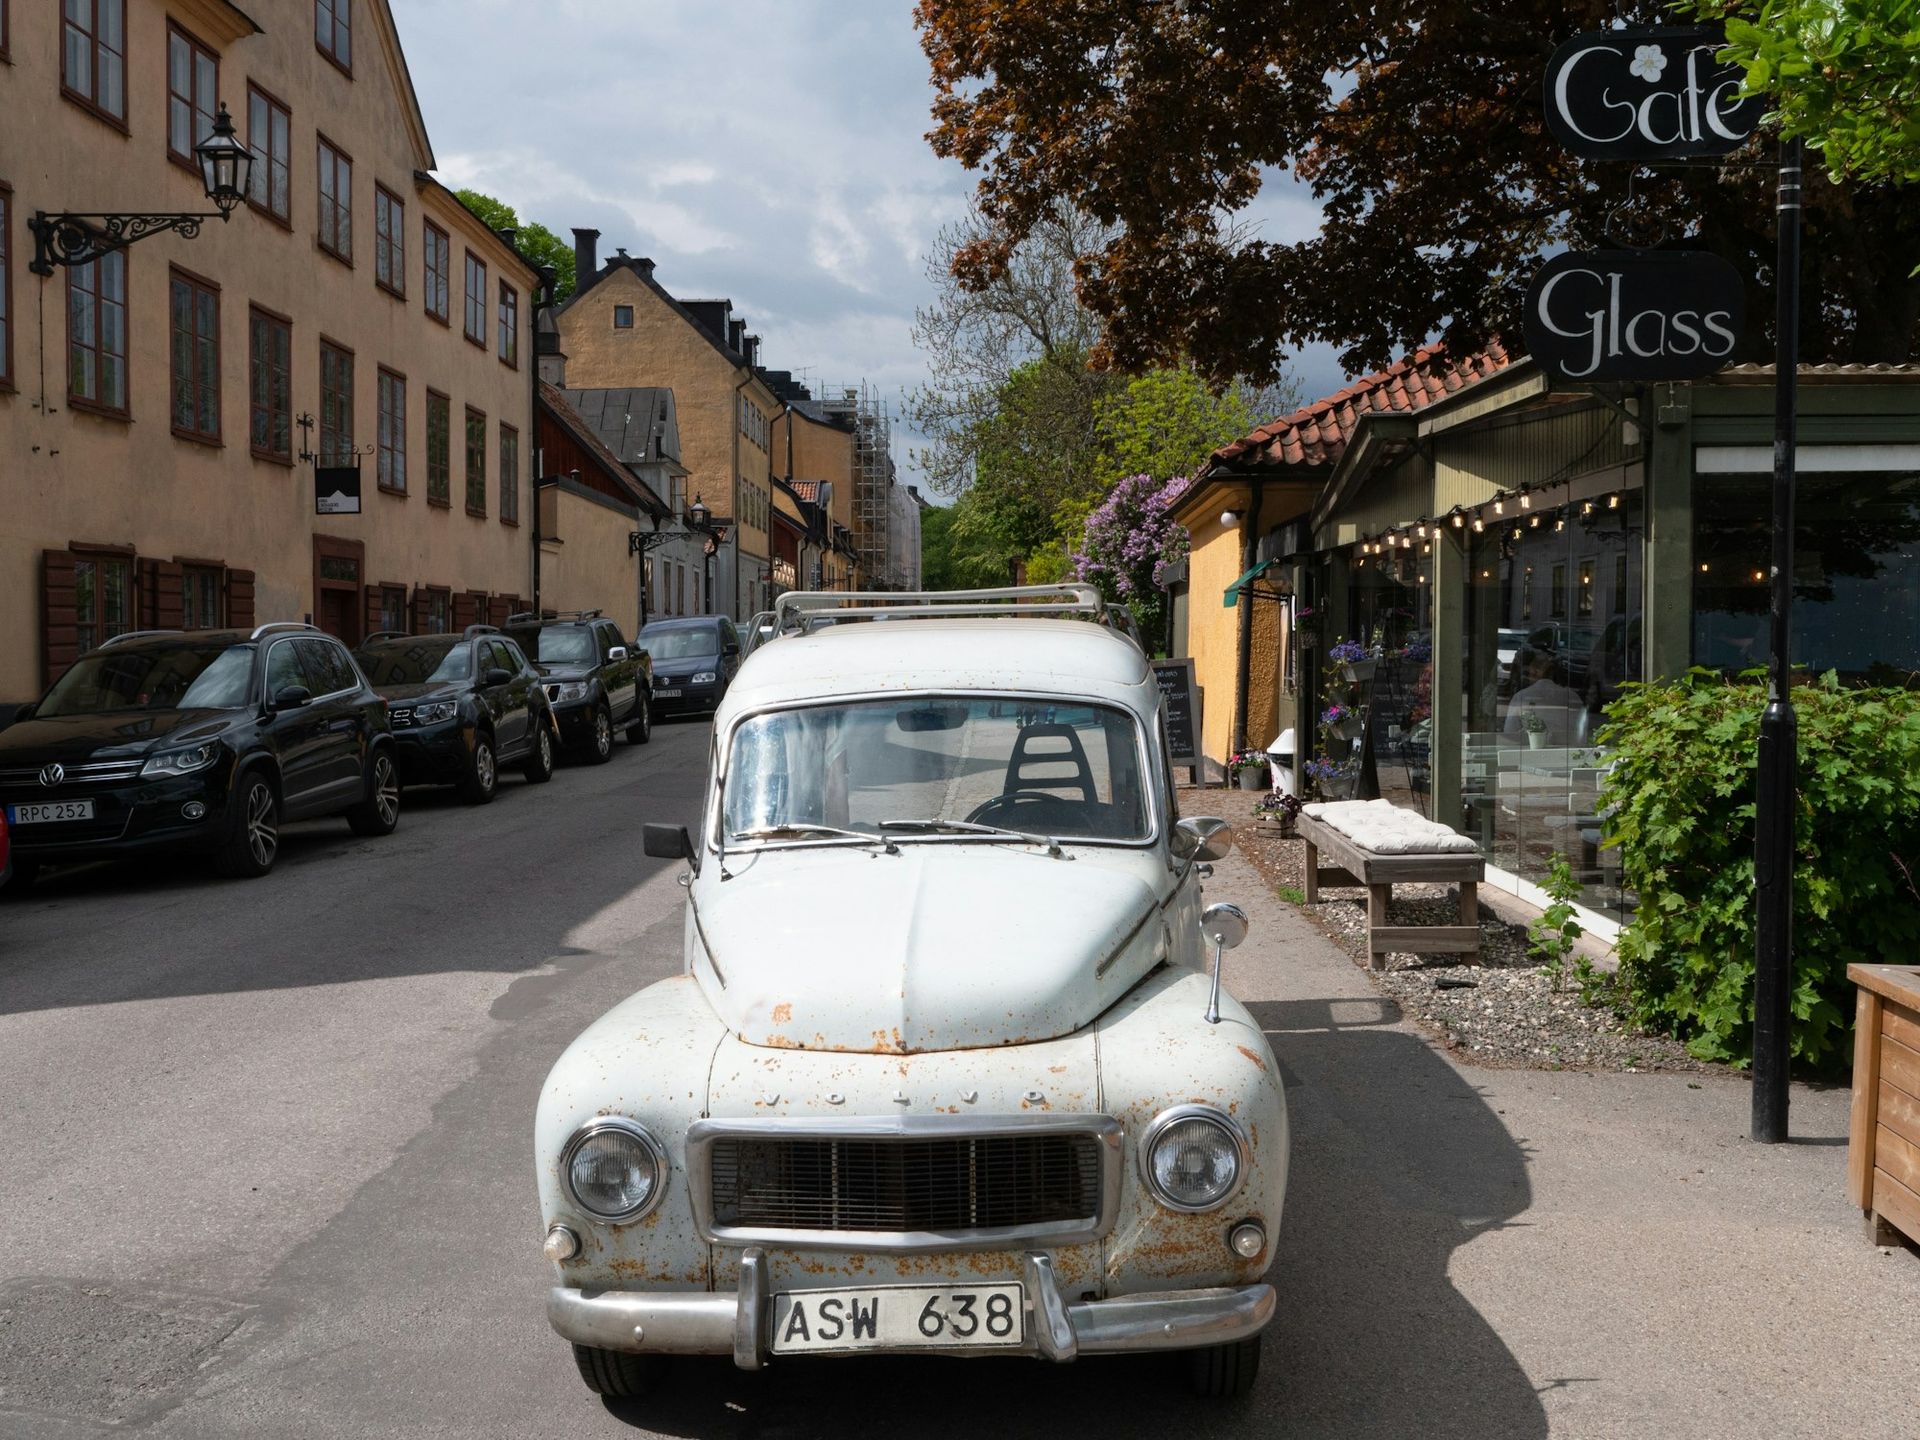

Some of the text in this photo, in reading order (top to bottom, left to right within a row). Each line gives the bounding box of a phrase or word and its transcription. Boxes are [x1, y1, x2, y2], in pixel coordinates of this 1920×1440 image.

[1538, 269, 1735, 377] Glass
[20, 803, 86, 821] RPC 252
[761, 1089, 1046, 1106] VOLVO
[784, 1293, 1013, 1342] ASW 638
